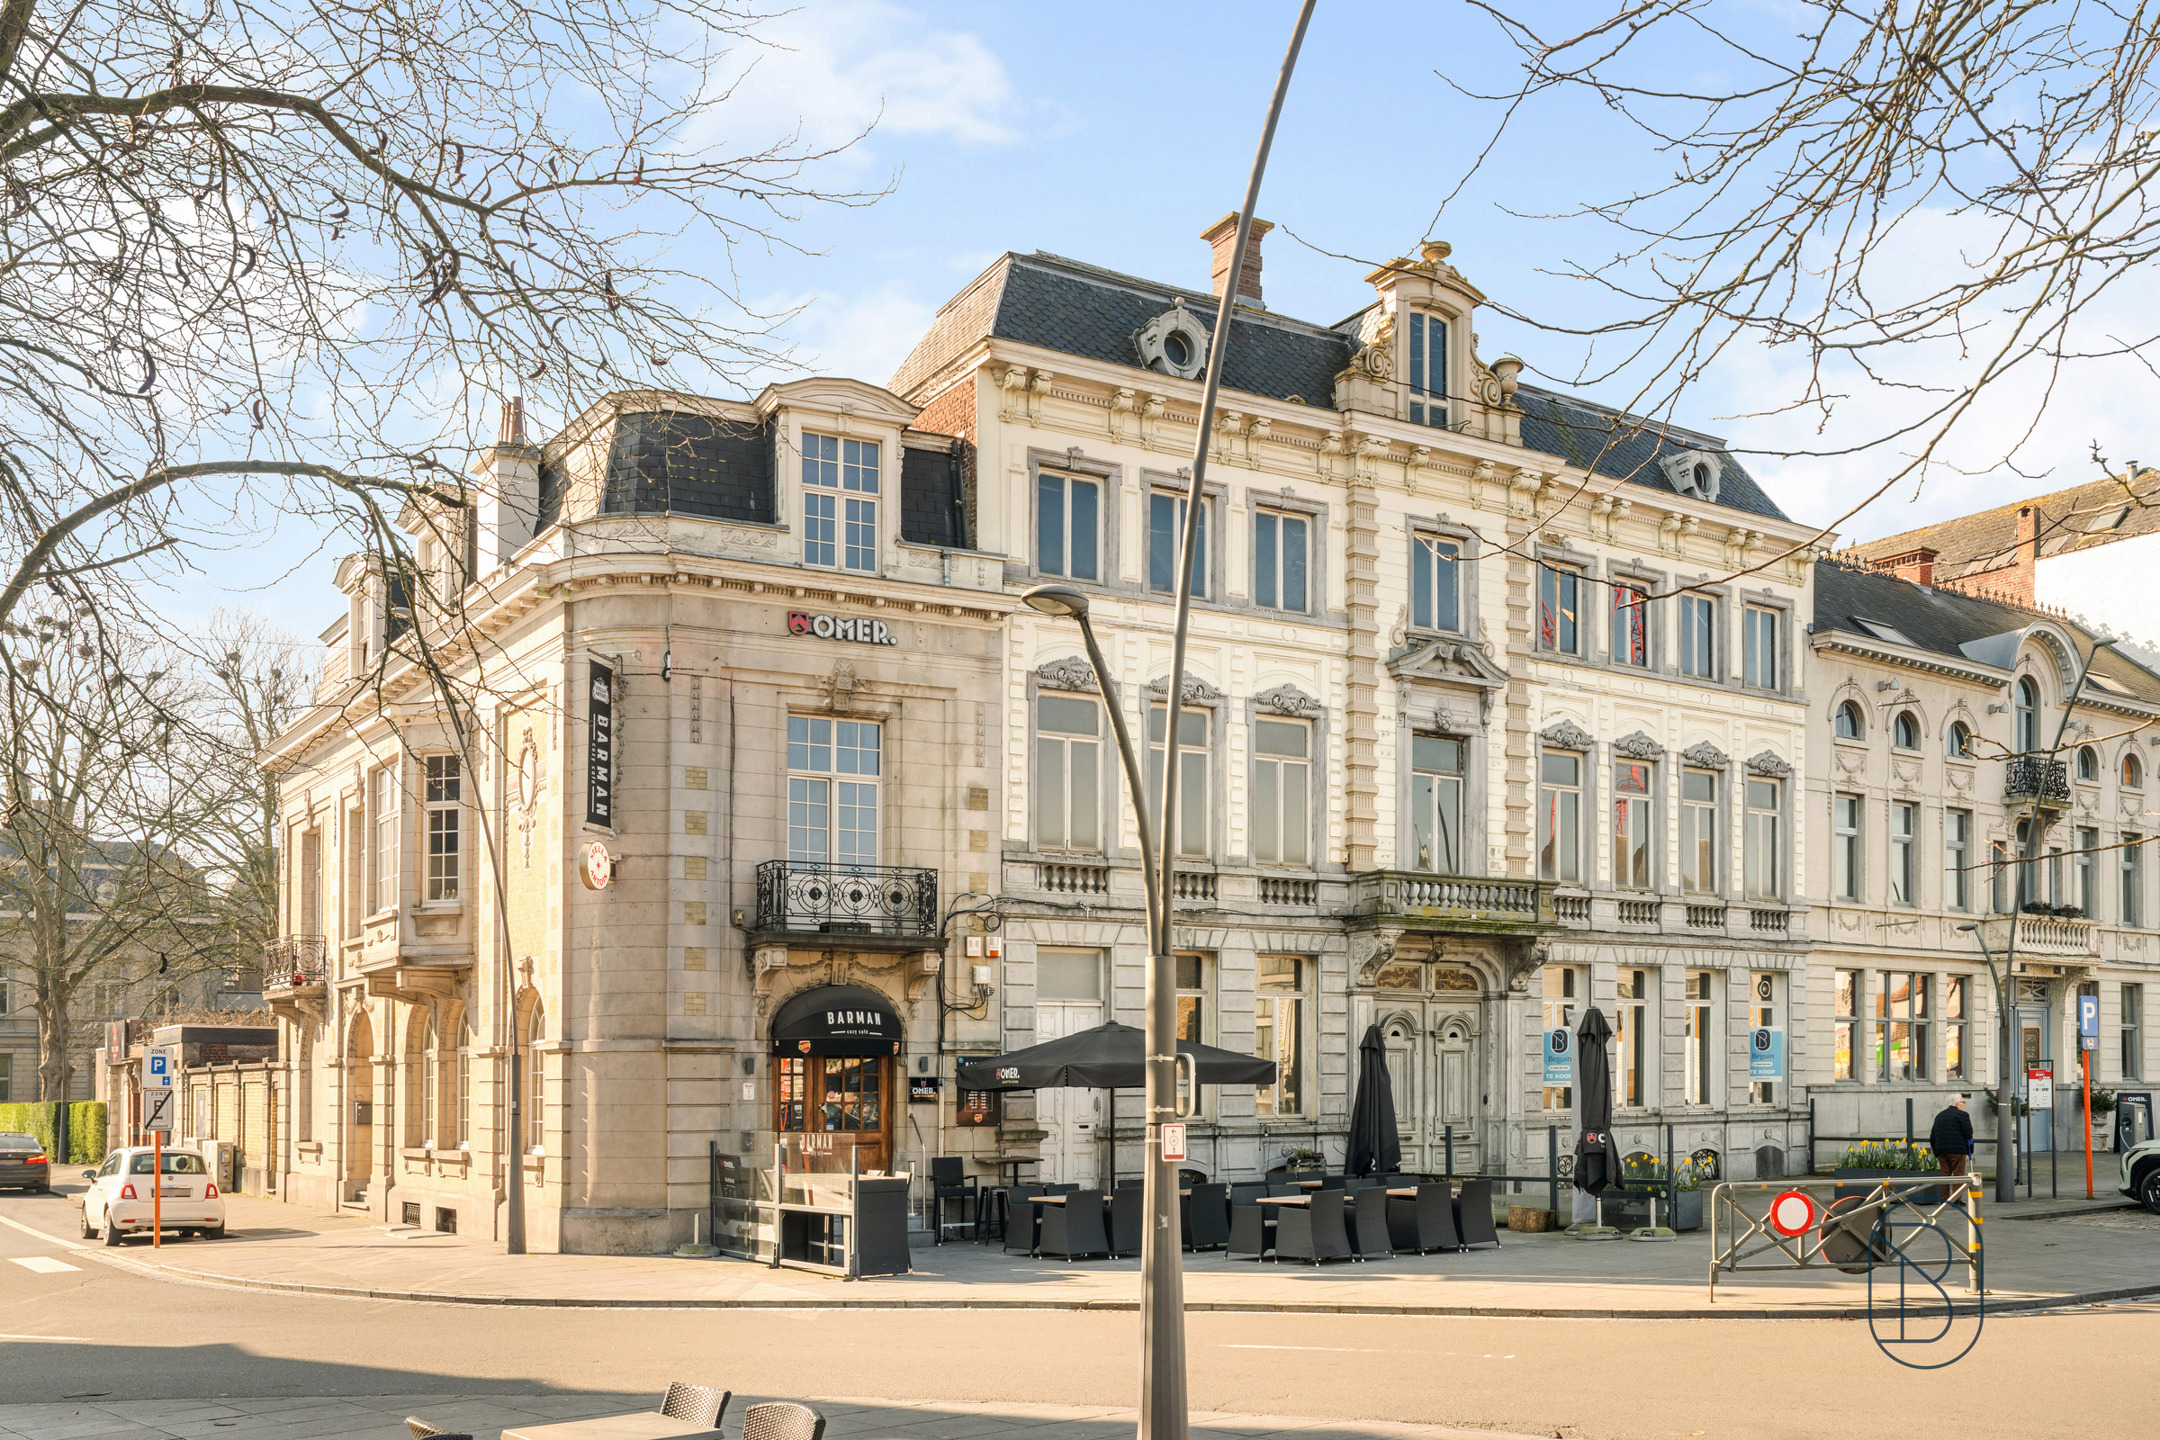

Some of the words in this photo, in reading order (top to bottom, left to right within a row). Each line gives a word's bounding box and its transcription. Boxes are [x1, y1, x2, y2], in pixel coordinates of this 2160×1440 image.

[812, 614, 898, 645] OMER.
[596, 714, 609, 816] BARMAN
[590, 845, 608, 863] STELLA
[590, 870, 608, 886] ARTOIS
[827, 1011, 881, 1025] BARMAN
[2083, 1002, 2096, 1030] P
[1548, 1055, 1572, 1065] Beguin
[1751, 1052, 1775, 1061] Beguin
[154, 1059, 163, 1071] P
[912, 1087, 936, 1095] OMER.
[800, 1134, 833, 1150] BARMAN
